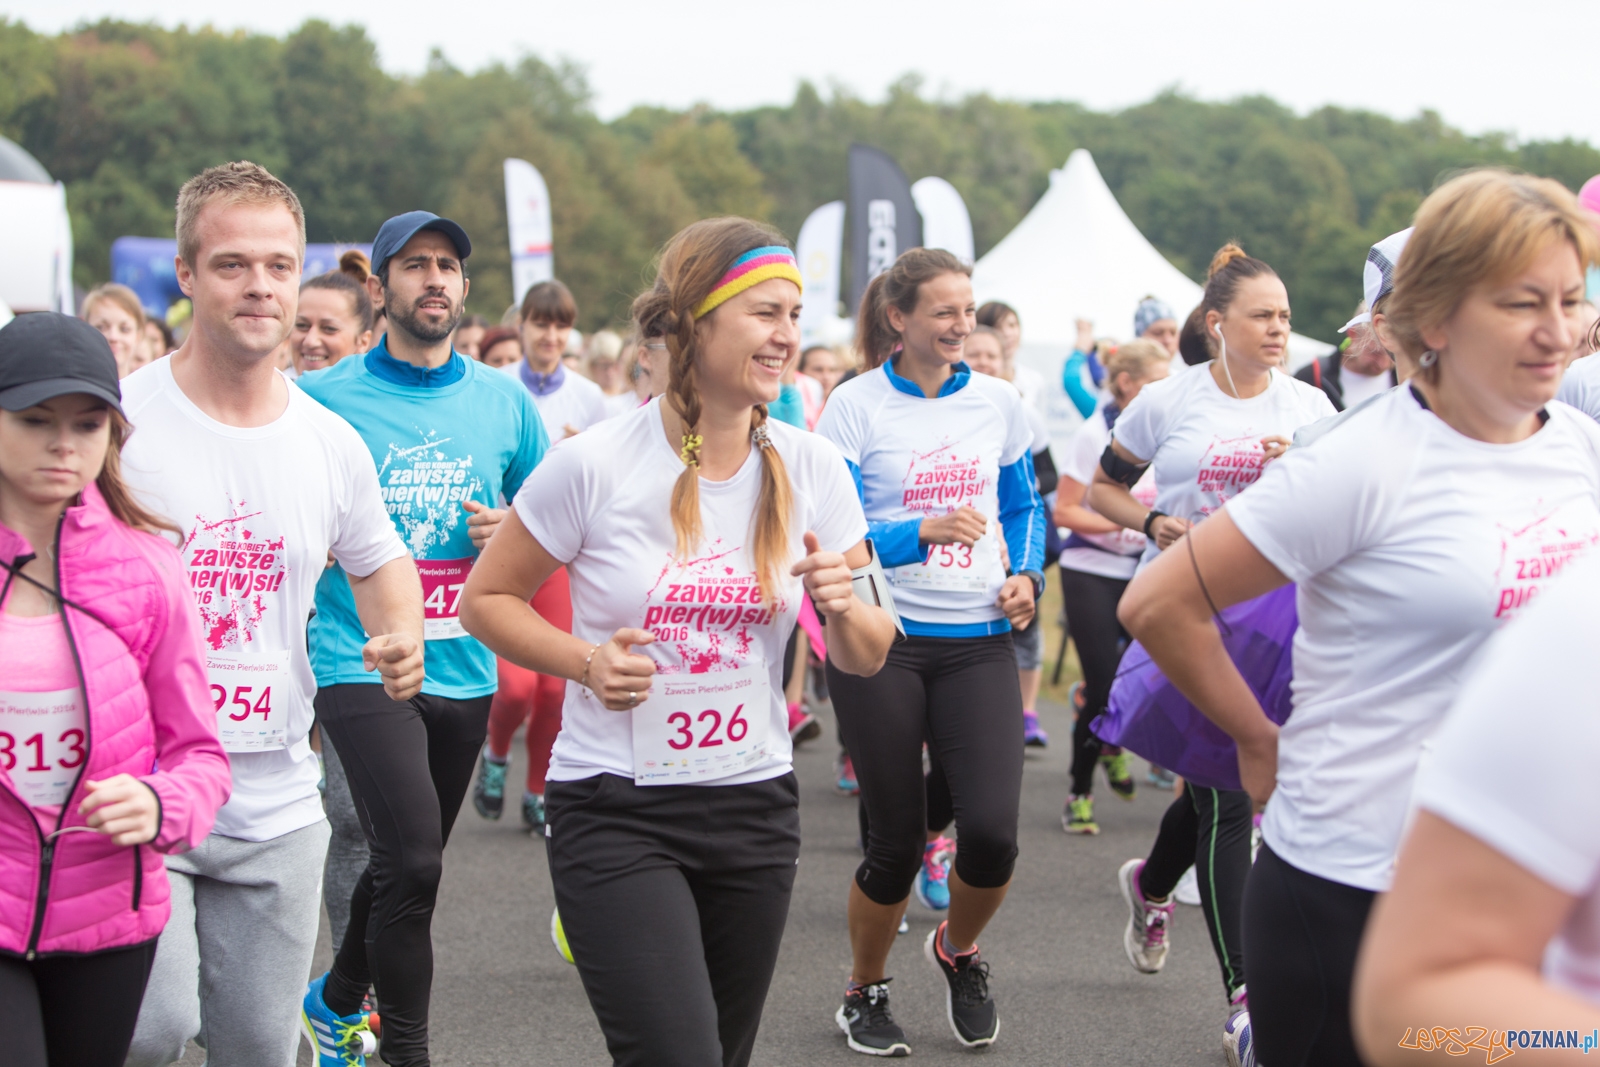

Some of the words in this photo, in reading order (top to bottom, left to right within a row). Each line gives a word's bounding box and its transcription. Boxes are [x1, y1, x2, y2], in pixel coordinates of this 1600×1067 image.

[388, 469, 466, 485] zawsze
[914, 468, 977, 485] zawsze
[903, 480, 985, 506] pier(w)si!
[907, 502, 932, 512] 2016
[220, 540, 236, 549] BIEG
[237, 541, 266, 552] KOBIET
[190, 549, 275, 570] zawsze
[446, 567, 461, 575] 2016
[187, 568, 285, 598] ier(w)si!
[720, 577, 752, 585] KOBIET
[665, 584, 762, 604] zawsze
[651, 626, 688, 642] 2016
[206, 661, 235, 671] Zawsze
[237, 664, 265, 672] Pier(w)si
[265, 664, 278, 672] 2016
[664, 687, 696, 695] Zawsze
[698, 684, 733, 694] Pier(w)si
[734, 678, 752, 689] 2016
[209, 684, 271, 721] 954
[667, 703, 748, 750] 326
